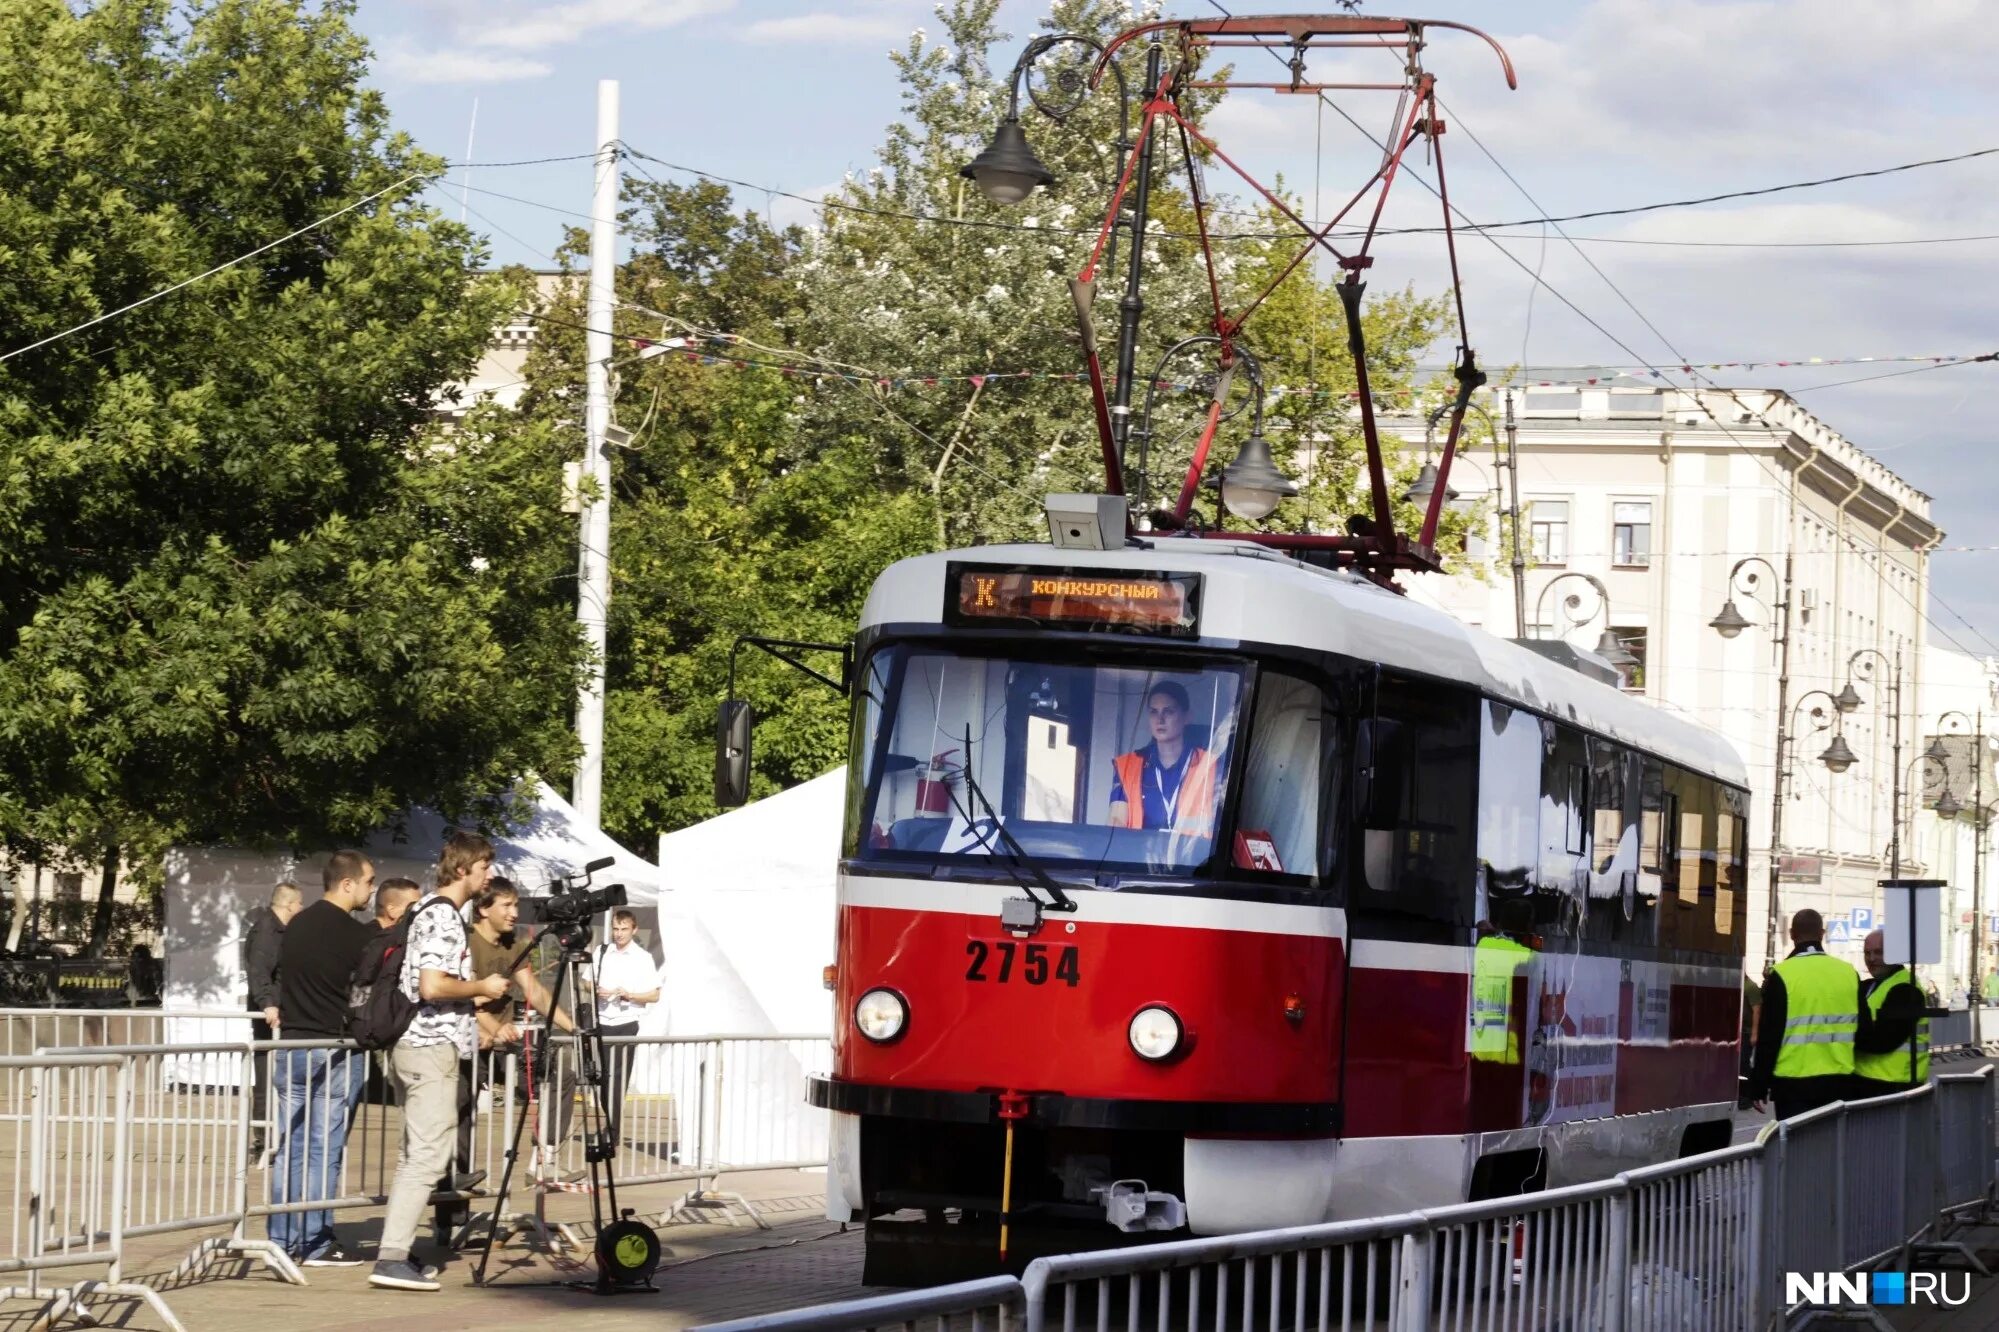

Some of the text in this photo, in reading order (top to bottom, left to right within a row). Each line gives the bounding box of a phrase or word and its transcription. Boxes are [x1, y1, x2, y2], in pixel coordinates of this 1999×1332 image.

[975, 578, 1159, 606] К КОНКУРСНЫЙ
[965, 940, 1081, 988] 2754
